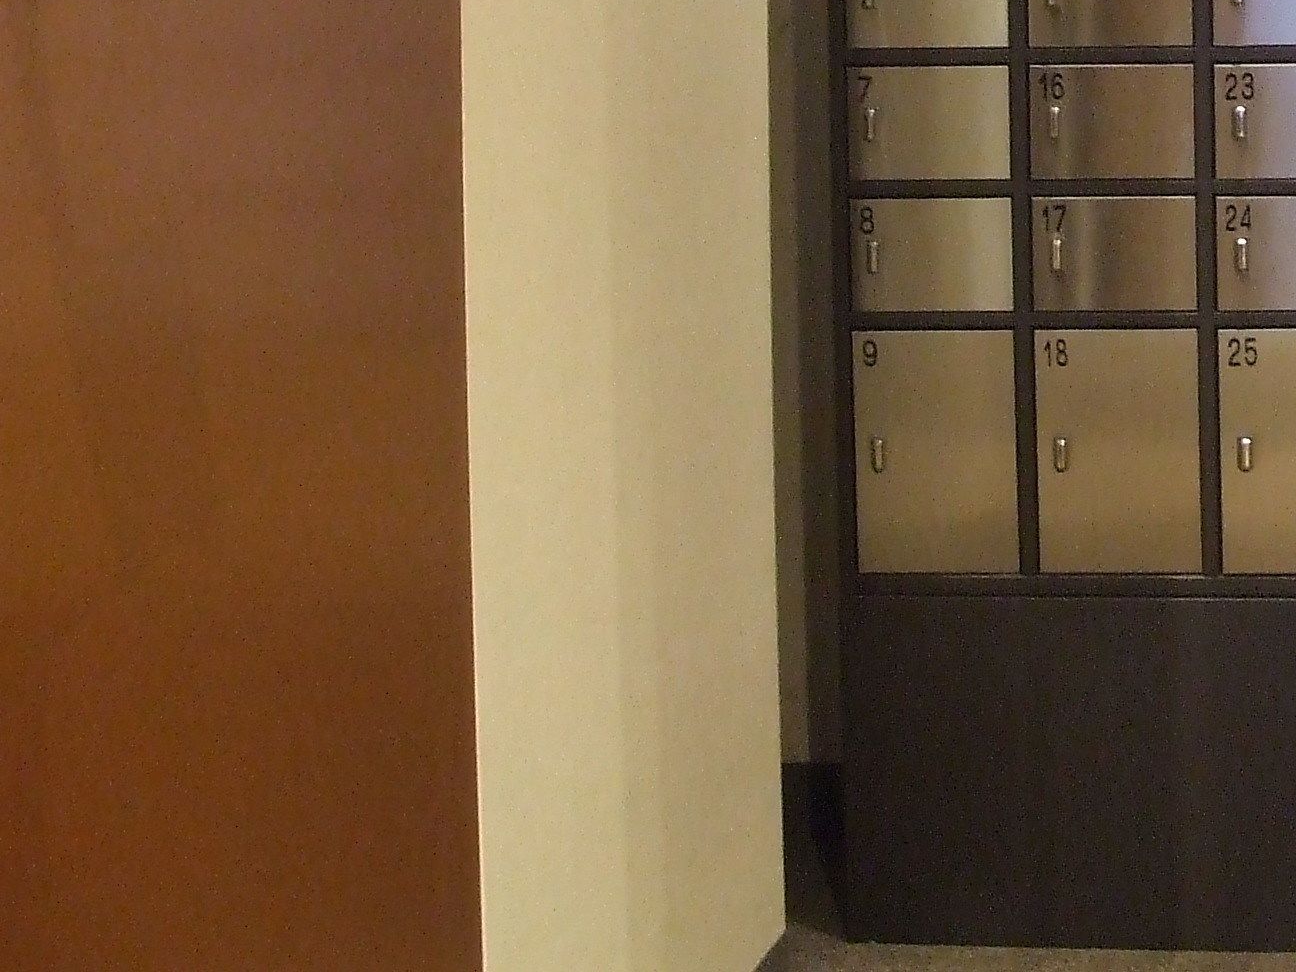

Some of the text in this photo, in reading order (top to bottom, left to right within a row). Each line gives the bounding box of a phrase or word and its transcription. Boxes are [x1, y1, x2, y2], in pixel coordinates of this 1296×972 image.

[857, 75, 873, 103] 7
[1039, 73, 1064, 101] 16
[1224, 71, 1252, 100] 23
[860, 207, 875, 235] 8
[1042, 205, 1066, 234] 17
[1225, 203, 1252, 232] 24
[863, 339, 878, 367] 9
[1044, 338, 1069, 366] 18
[1227, 337, 1258, 365] 25
